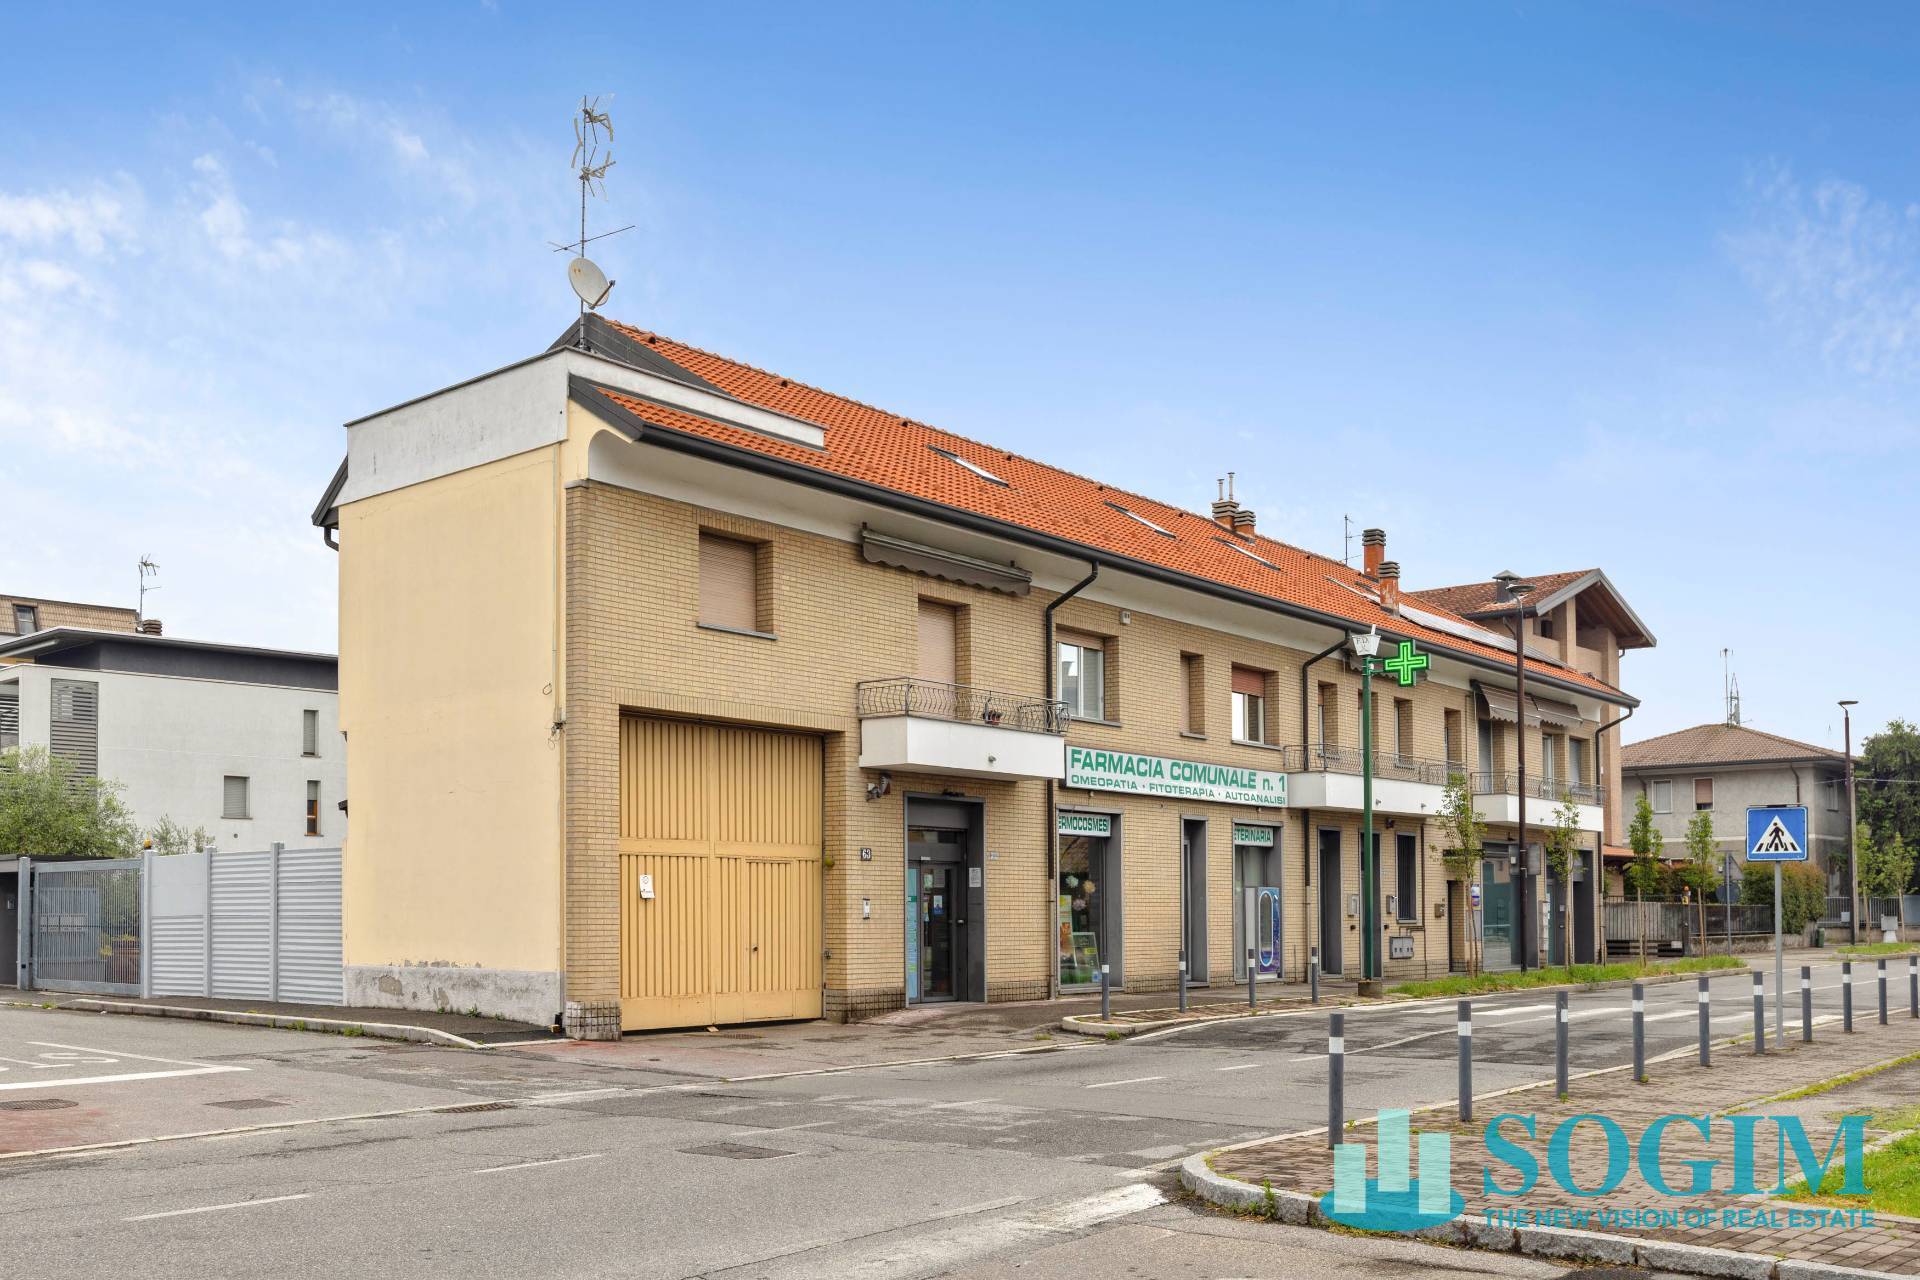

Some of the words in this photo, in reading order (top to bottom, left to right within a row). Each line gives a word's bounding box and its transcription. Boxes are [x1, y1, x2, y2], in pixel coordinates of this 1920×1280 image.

[1071, 748, 1164, 779] FARMACIA
[1170, 761, 1257, 789] COMUNALE
[1262, 777, 1274, 791] n.
[1279, 775, 1285, 792] 1
[1071, 774, 1138, 790] OMEOPATIA
[1149, 782, 1215, 798] FITOTERAPIA
[1225, 791, 1286, 805] AUTOANALISI
